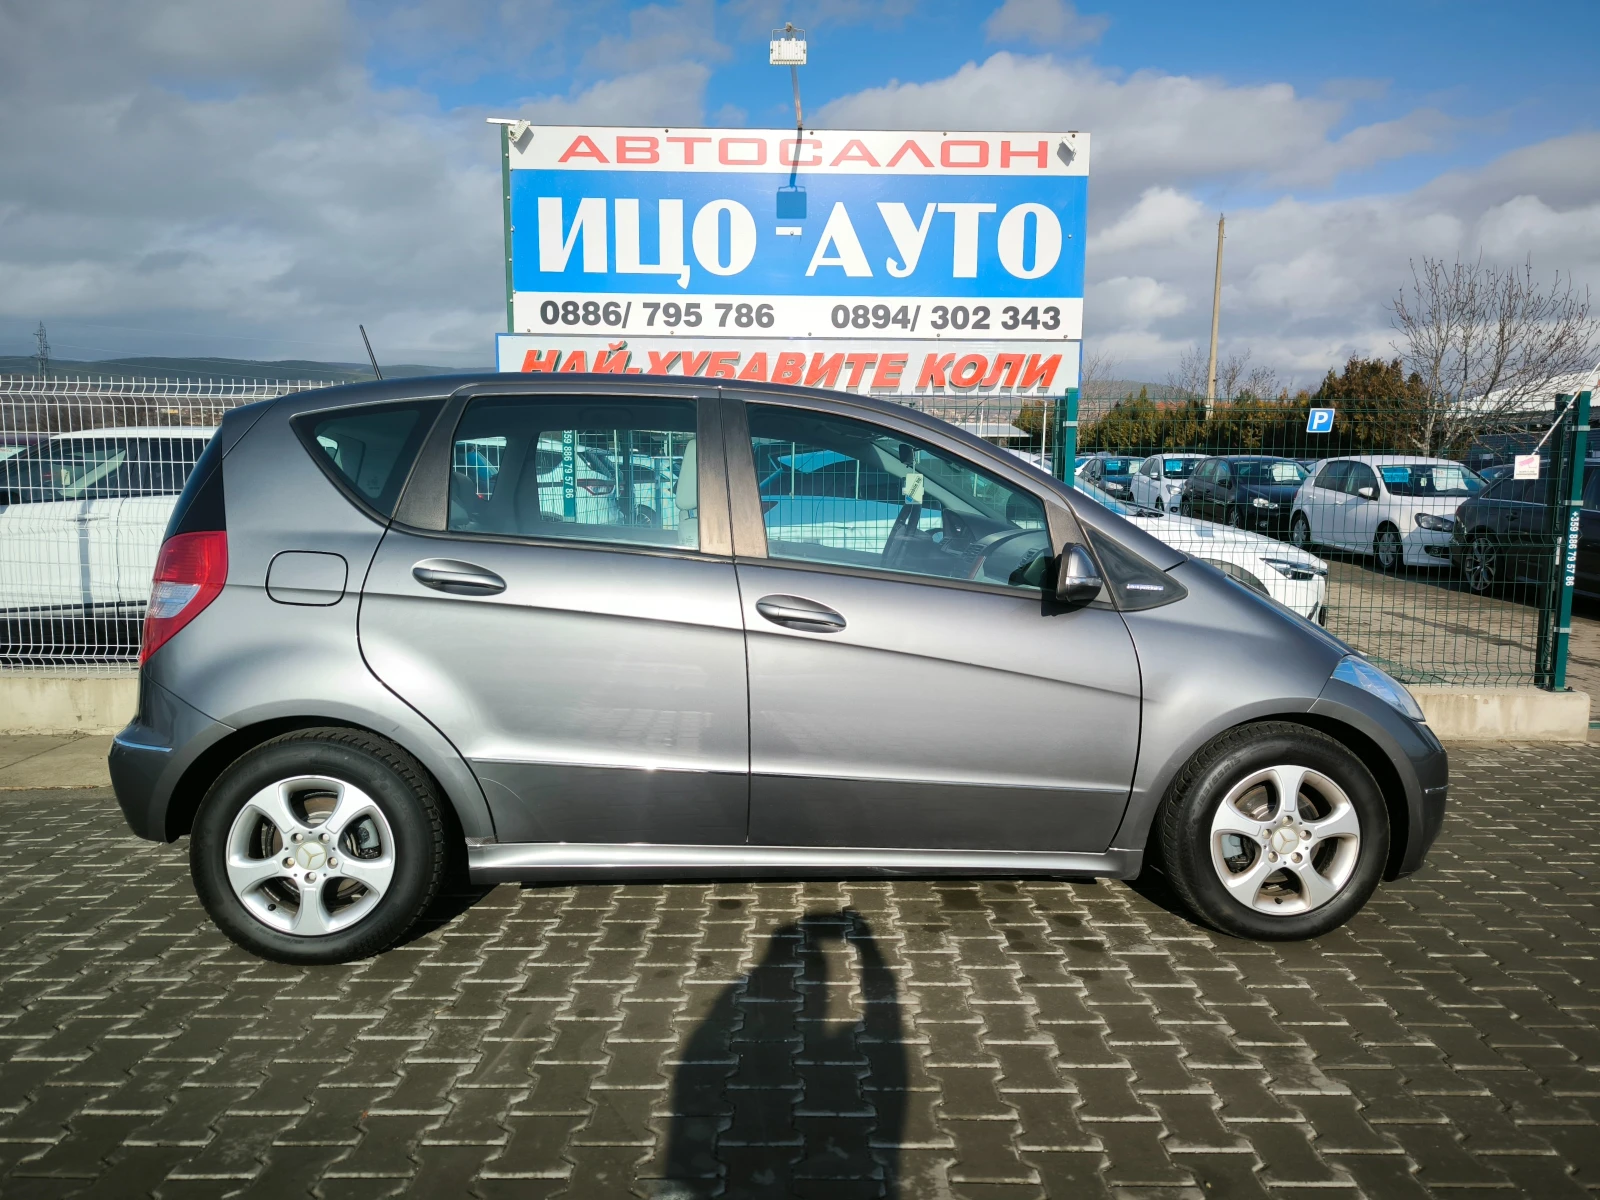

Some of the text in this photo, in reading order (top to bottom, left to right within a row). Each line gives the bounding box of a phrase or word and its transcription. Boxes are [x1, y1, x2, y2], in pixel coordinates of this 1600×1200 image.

[558, 135, 1049, 168] АВТОСАЛОН
[538, 197, 757, 289] ИЦО
[540, 300, 775, 329] 0886/ 795 786
[831, 304, 1061, 332] 0894/ 302 343
[915, 353, 1063, 387] КОЛИ
[1312, 411, 1329, 430] P
[563, 446, 573, 462] 886
[564, 463, 573, 474] 79
[564, 476, 574, 486] 57
[565, 488, 574, 499] 86
[1565, 511, 1580, 587] +359 886 79 57 86
